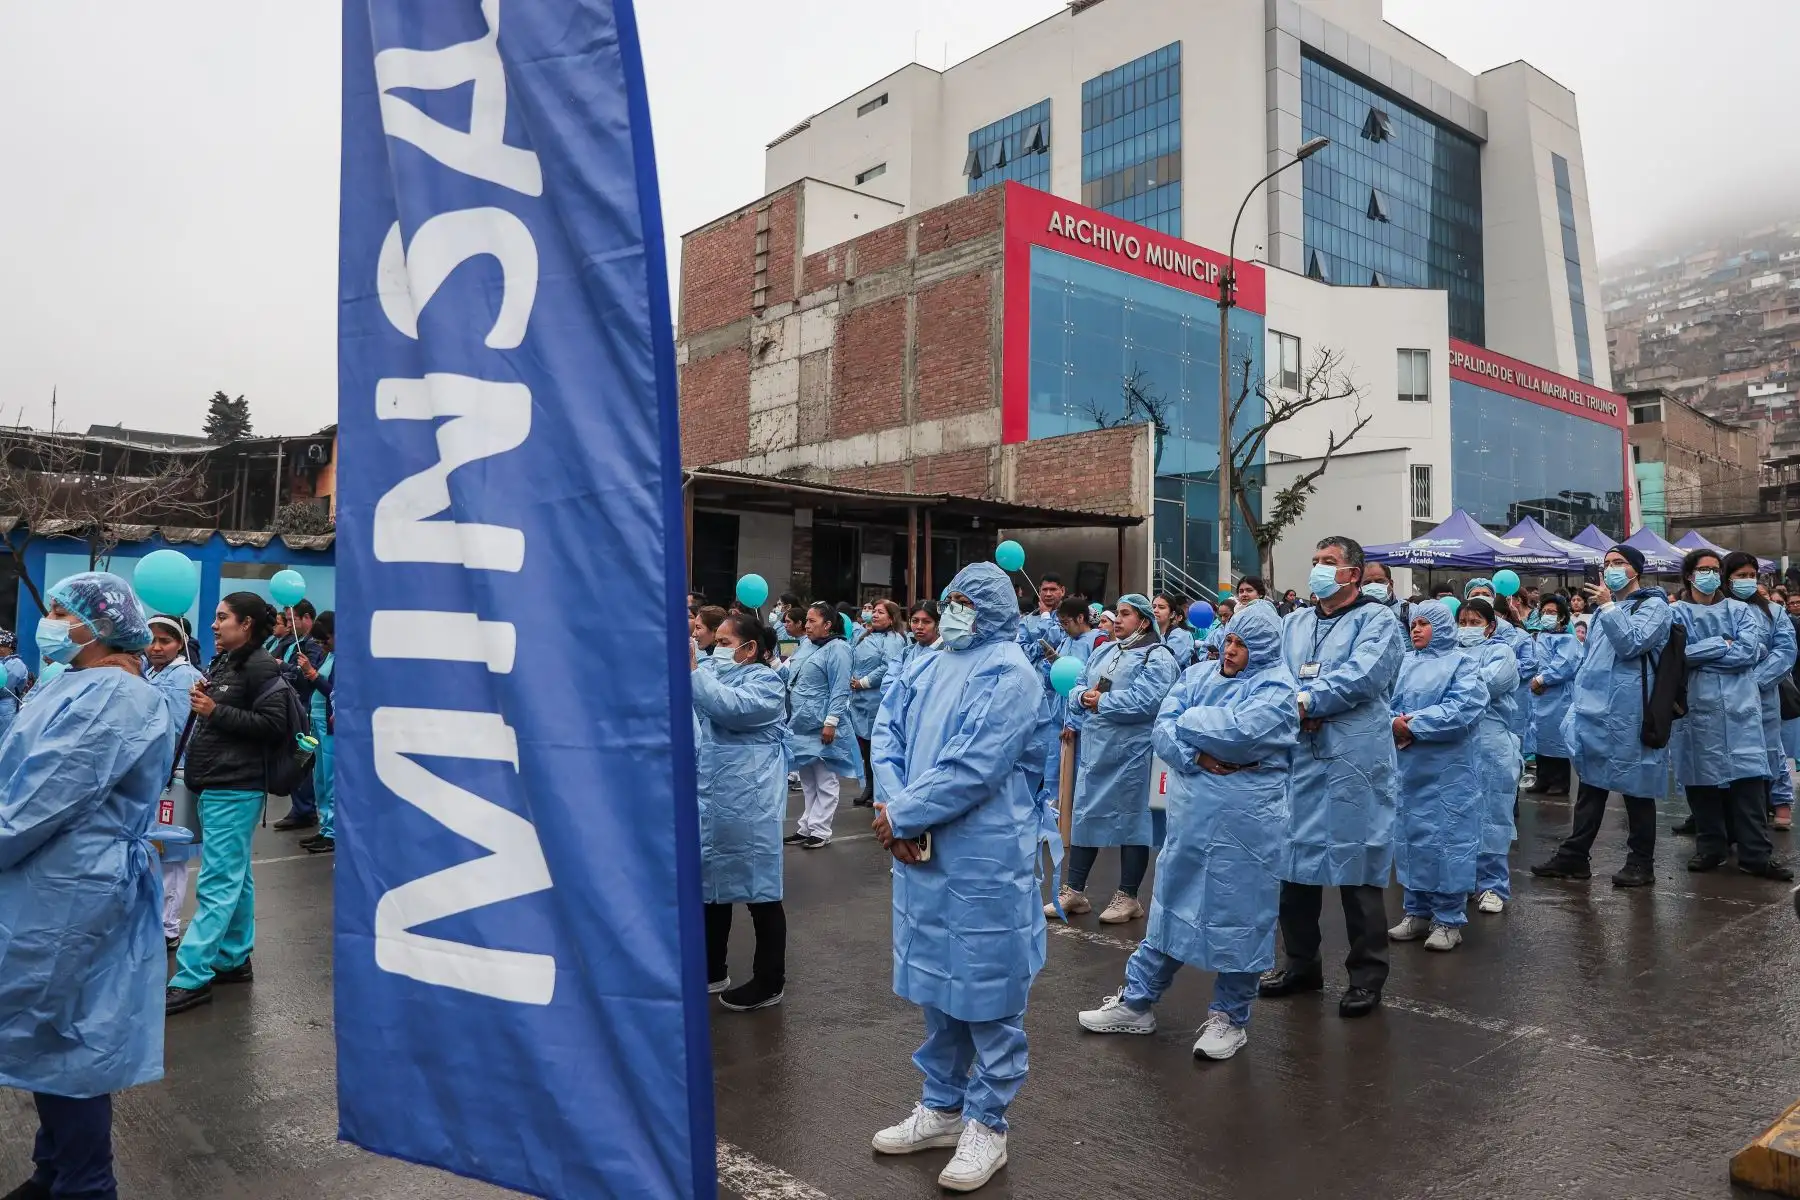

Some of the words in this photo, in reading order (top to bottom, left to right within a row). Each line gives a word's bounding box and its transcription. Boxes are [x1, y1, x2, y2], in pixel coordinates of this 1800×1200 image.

[1048, 211, 1140, 260] ARCHIVO
[1146, 242, 1239, 292] MUNICIPL
[1500, 366, 1513, 383] DE
[1514, 371, 1540, 392] VILLA
[1541, 379, 1568, 401] MARIA
[1569, 388, 1584, 406] DEL
[1585, 394, 1618, 417] TRIUNFO
[371, 0, 556, 1006] MINSA
[1409, 557, 1435, 565] Alcalde
